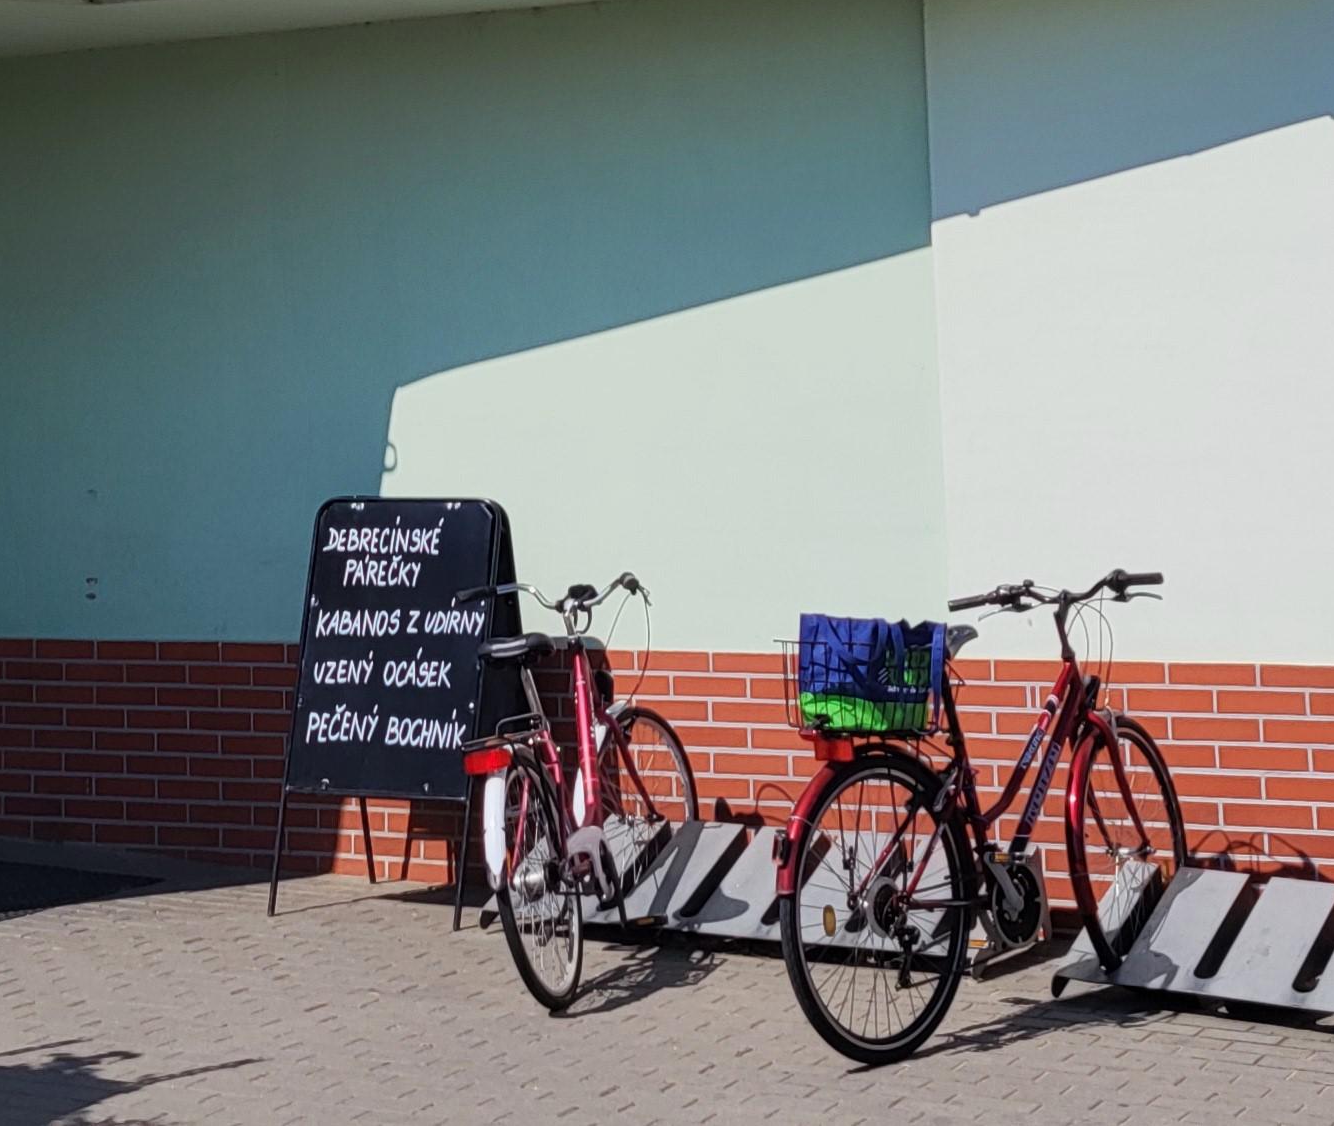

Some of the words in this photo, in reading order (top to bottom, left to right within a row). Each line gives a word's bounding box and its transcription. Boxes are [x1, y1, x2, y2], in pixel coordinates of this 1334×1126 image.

[323, 515, 444, 555] DEBRECÍNSKÉ
[343, 554, 421, 588] PÁREČKY
[315, 609, 401, 638] KABANOS
[406, 610, 421, 634] Z
[313, 650, 374, 685] UZENÝ
[382, 647, 453, 688] OCÁSEK
[305, 704, 379, 743] PEČENÝ
[385, 709, 467, 751] BOCHNÍK
